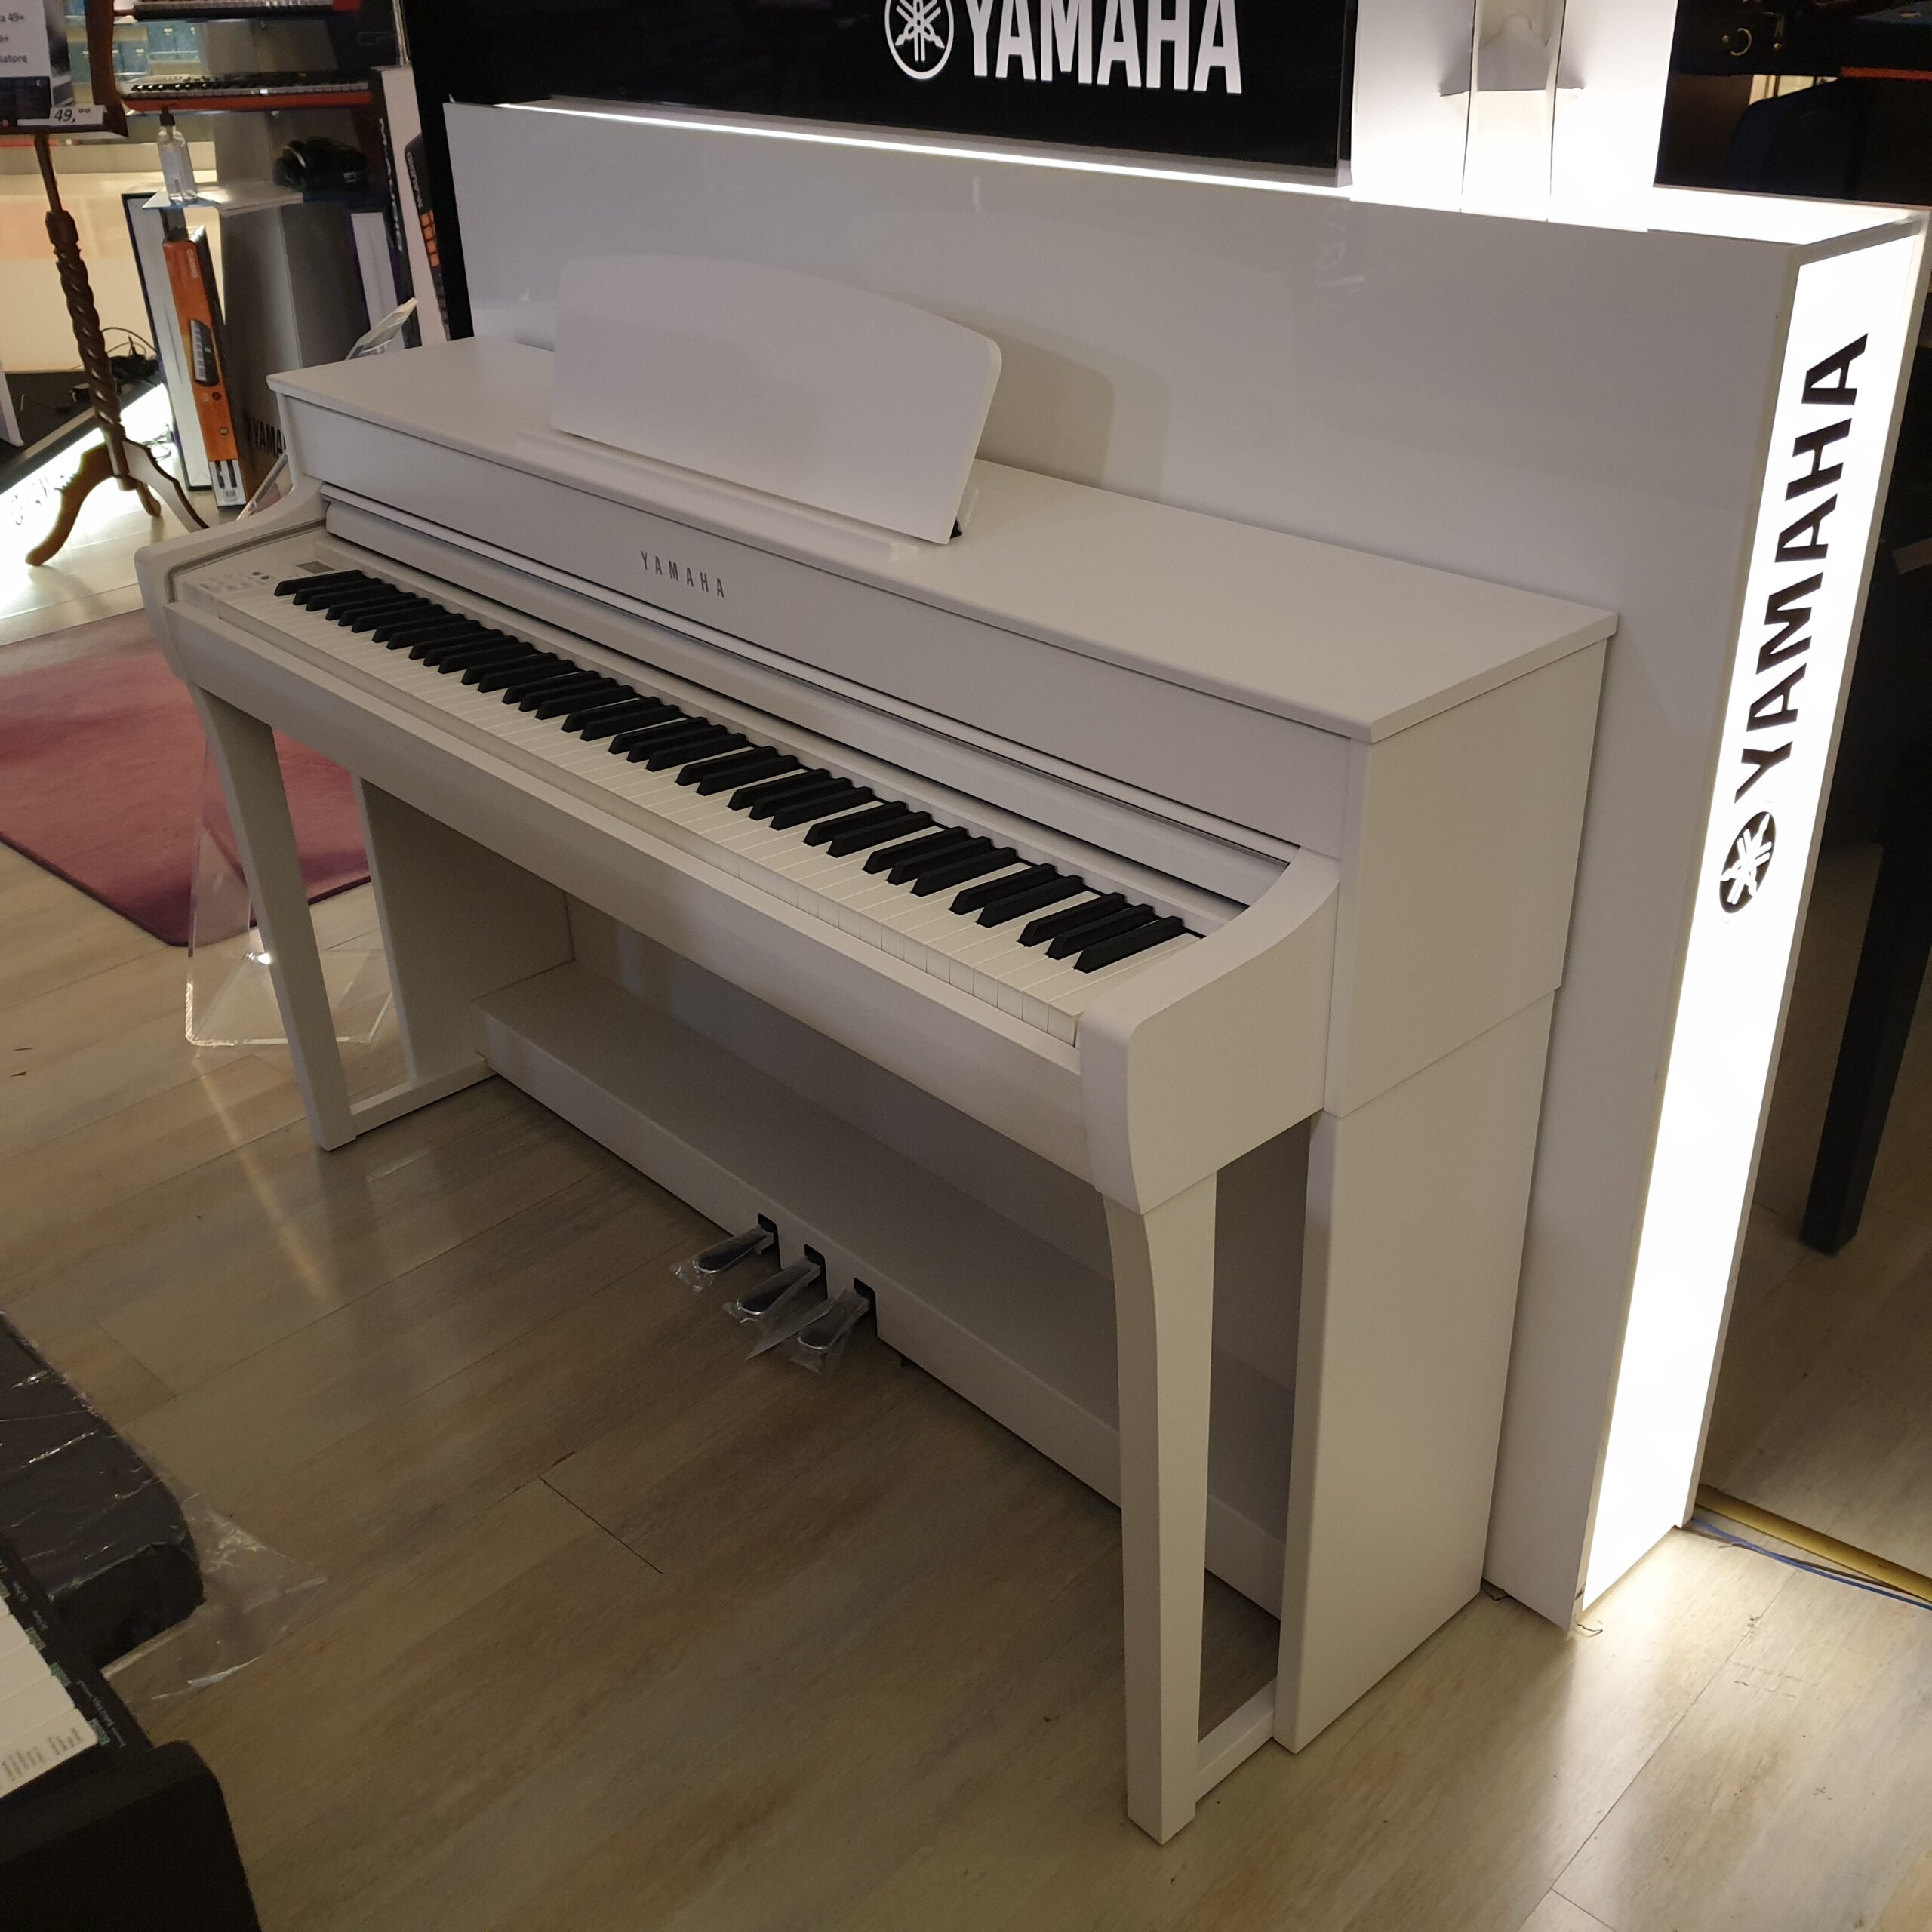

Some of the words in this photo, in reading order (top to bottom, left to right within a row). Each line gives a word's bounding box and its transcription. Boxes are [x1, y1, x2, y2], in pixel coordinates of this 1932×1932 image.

[968, 0, 1242, 94] YAMAHA
[641, 550, 724, 598] YAMAHA
[1734, 333, 1868, 804] YAMAHA
